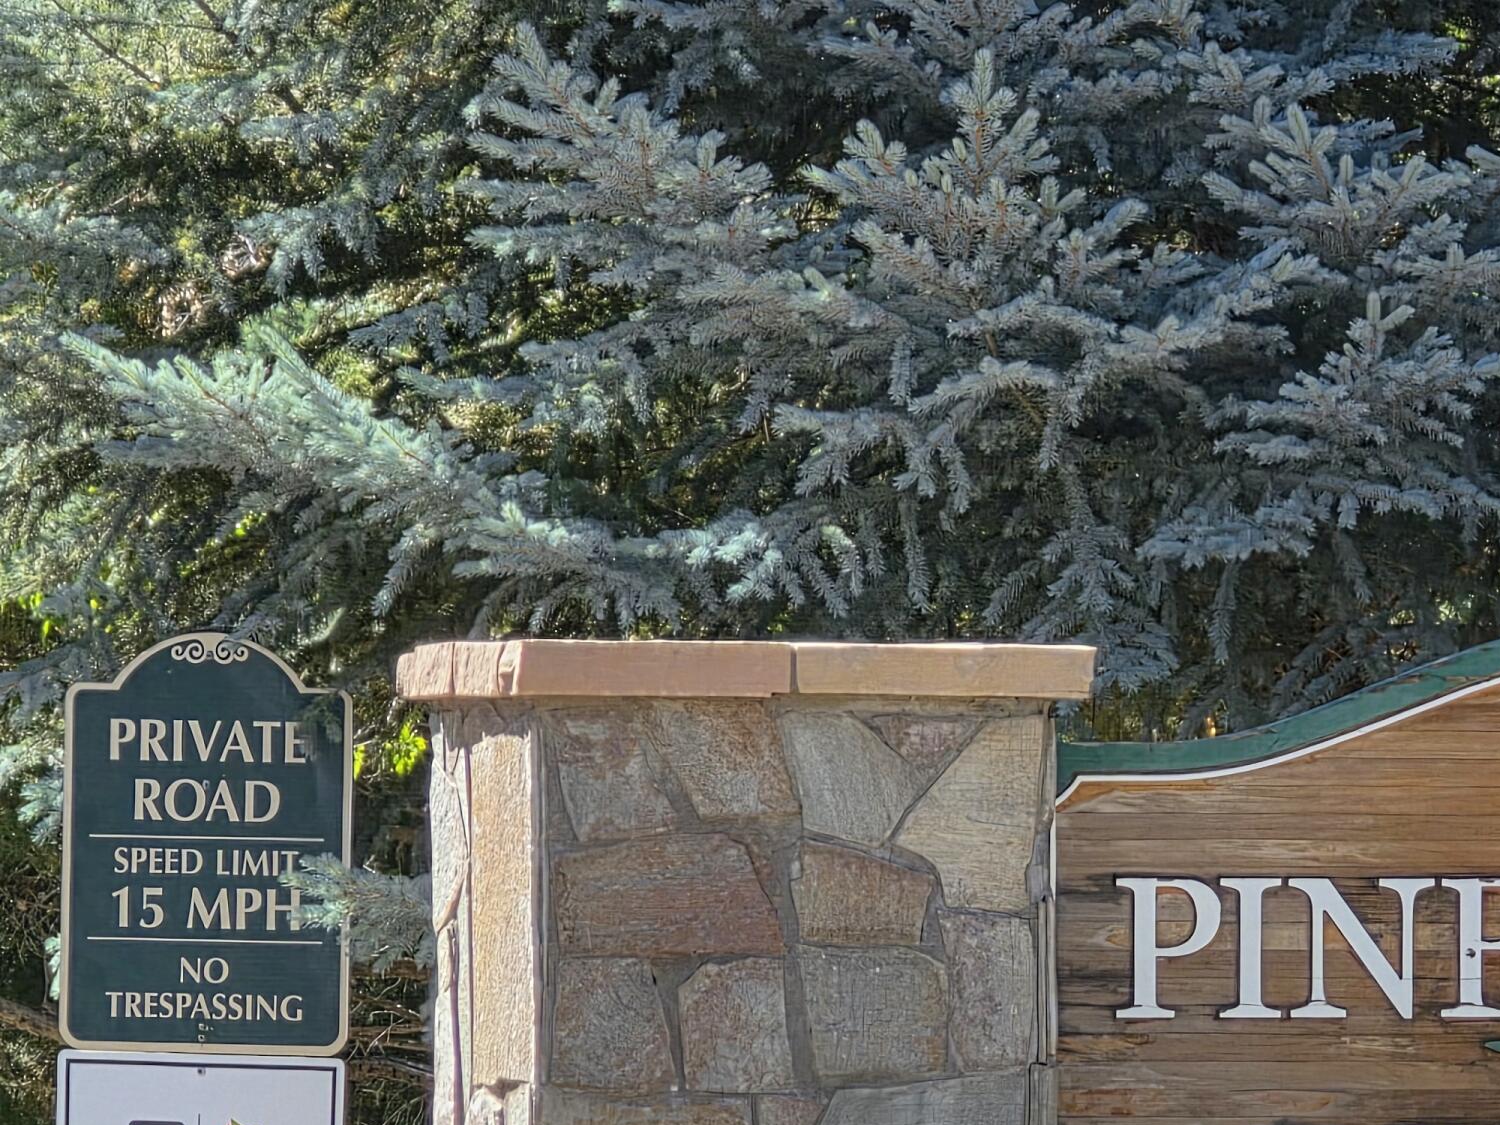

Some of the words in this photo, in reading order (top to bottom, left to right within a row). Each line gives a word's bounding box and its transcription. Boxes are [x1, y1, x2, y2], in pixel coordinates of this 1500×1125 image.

[109, 718, 307, 764] PRIVATE
[133, 778, 281, 824] ROAD
[113, 847, 203, 876] SPEED
[216, 849, 301, 878] LIMIT
[111, 886, 165, 929] 15
[186, 887, 301, 932] MPH
[178, 956, 230, 985] NO
[105, 991, 304, 1023] TRESPASSING
